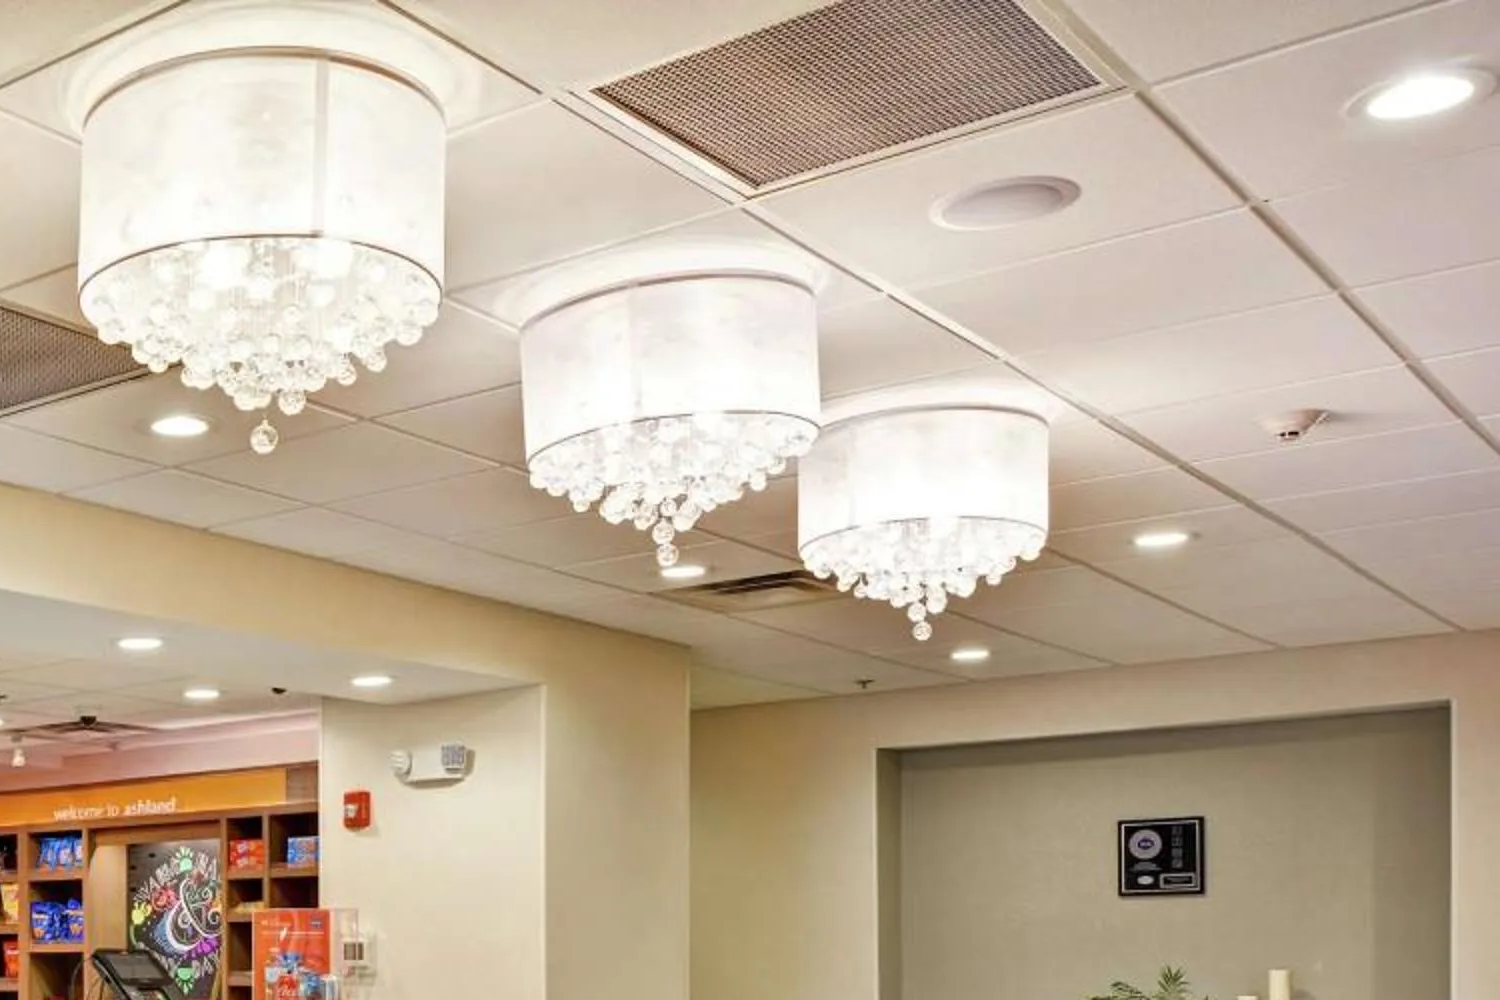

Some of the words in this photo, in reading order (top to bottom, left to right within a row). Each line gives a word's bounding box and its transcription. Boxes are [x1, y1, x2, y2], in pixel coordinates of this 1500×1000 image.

[54, 804, 104, 821] welcome
[106, 802, 120, 816] to
[124, 796, 177, 816] ashland
